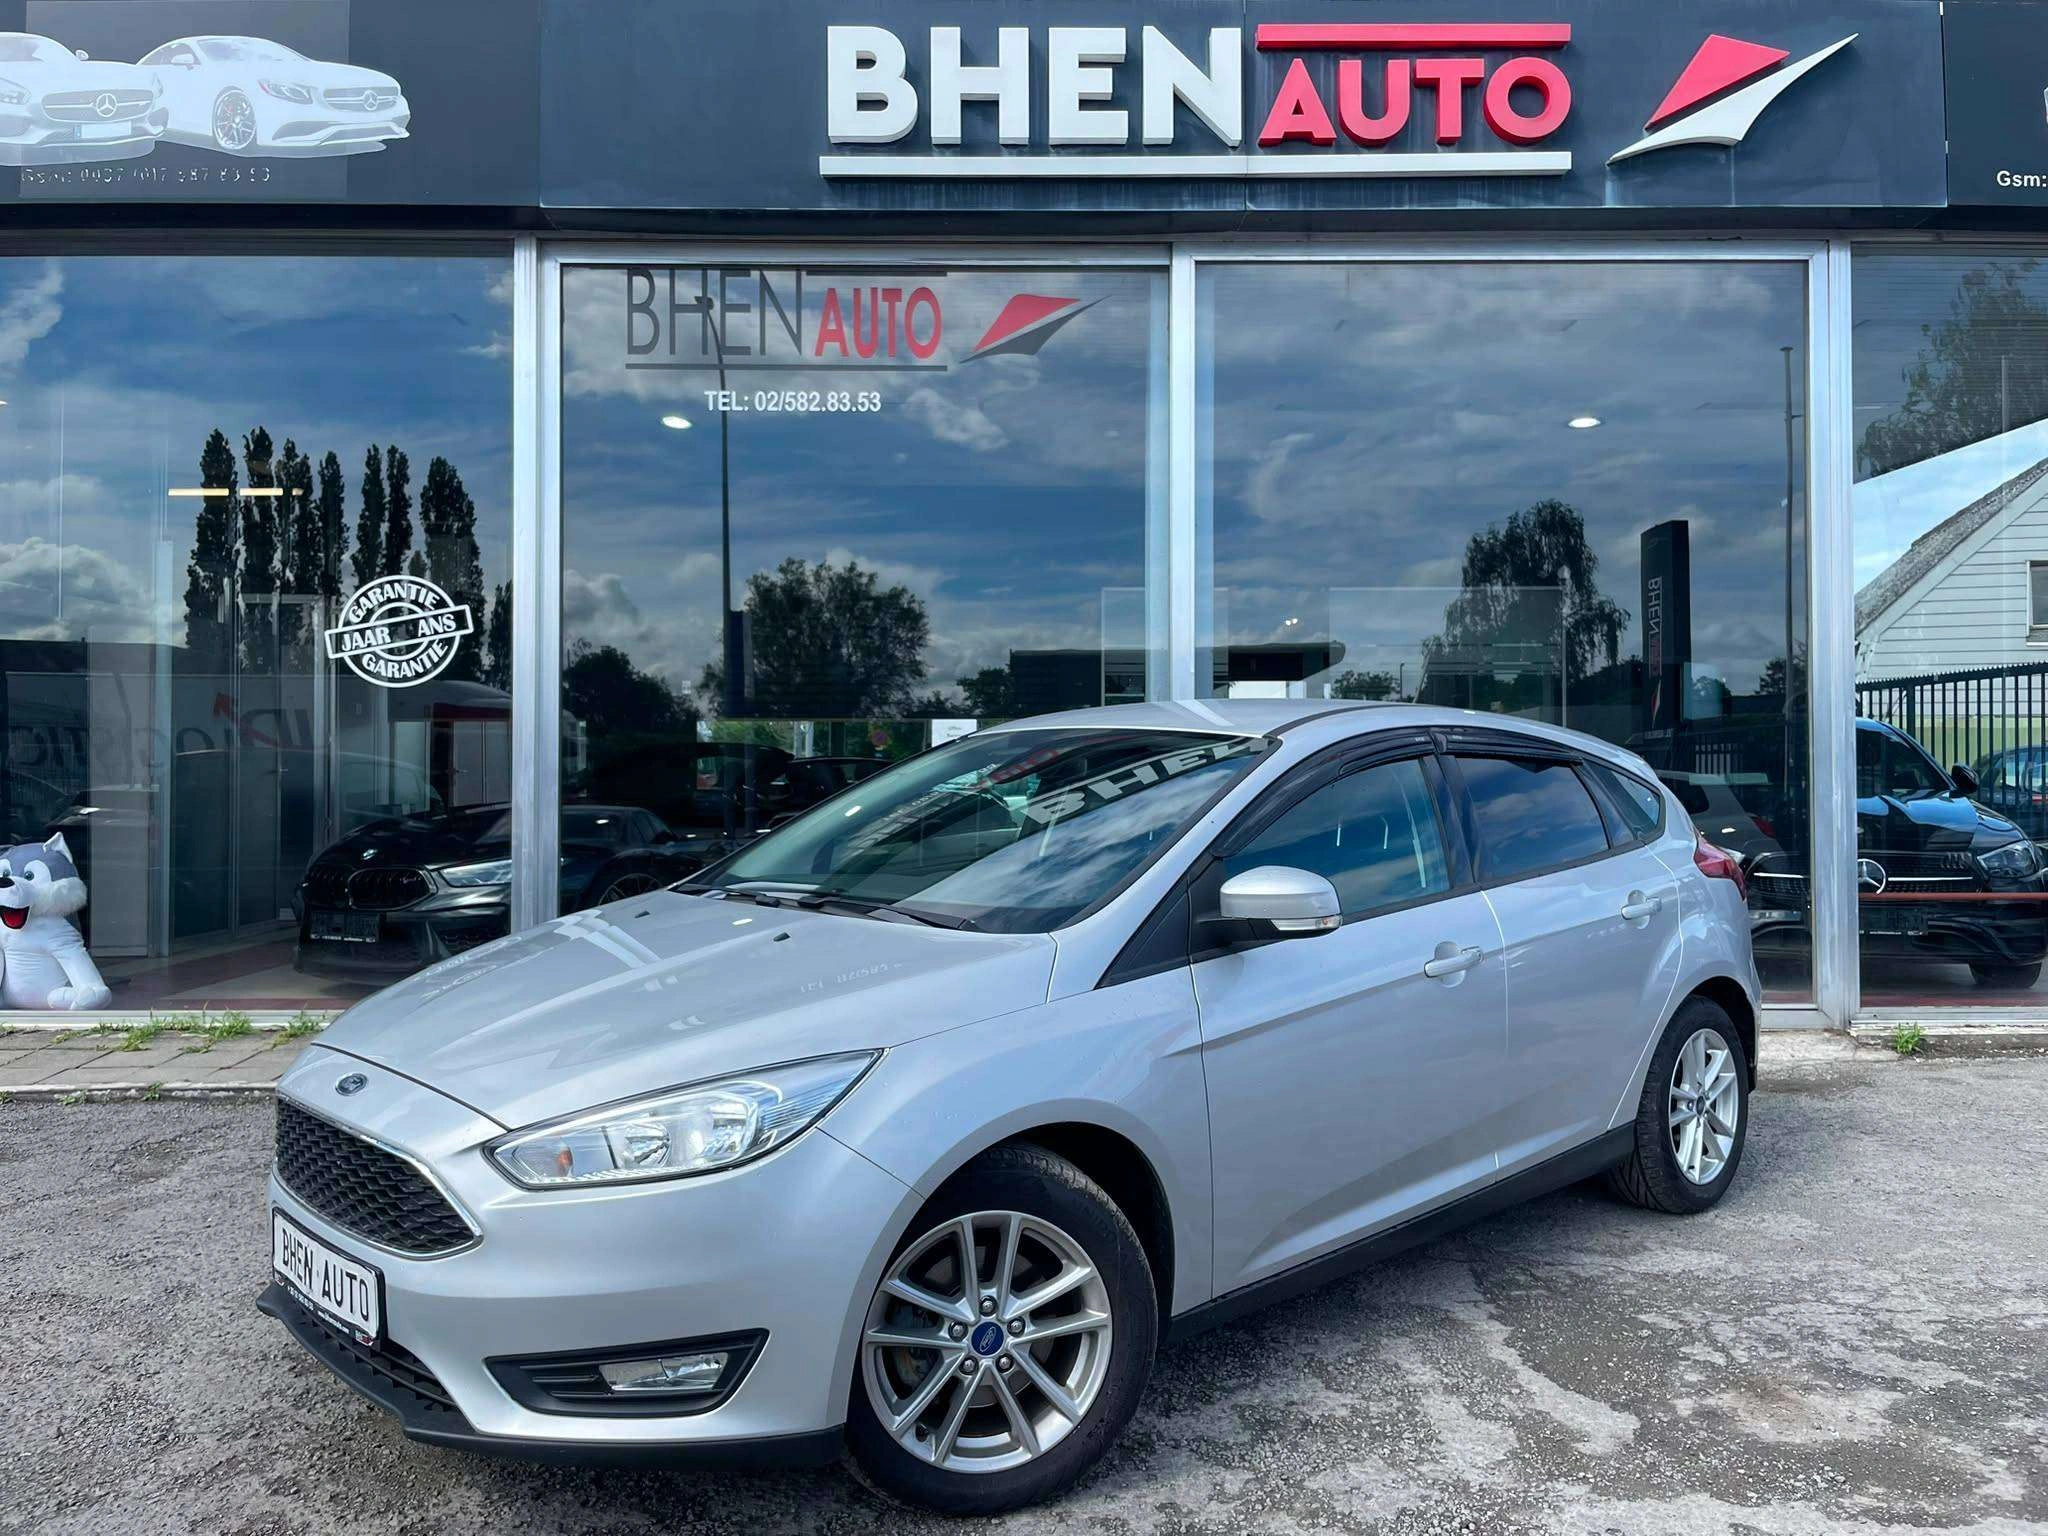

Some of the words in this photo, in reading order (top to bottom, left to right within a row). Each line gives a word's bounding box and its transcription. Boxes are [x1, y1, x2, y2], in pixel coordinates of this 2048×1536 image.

[827, 25, 1242, 147] BHEN
[1258, 56, 1573, 146] AUTO
[1996, 170, 2048, 187] Gsm:
[626, 269, 802, 355] BHEN
[814, 286, 943, 359] AUTO
[704, 391, 749, 412] TEL:
[754, 391, 881, 412] 02/582.83.53
[348, 582, 440, 624] GARANTIE
[341, 626, 392, 652] JAAR
[417, 613, 457, 638] ANS
[361, 640, 449, 679] GARANTIE
[282, 1227, 314, 1291] BHEN
[322, 1260, 369, 1322] AUTO
